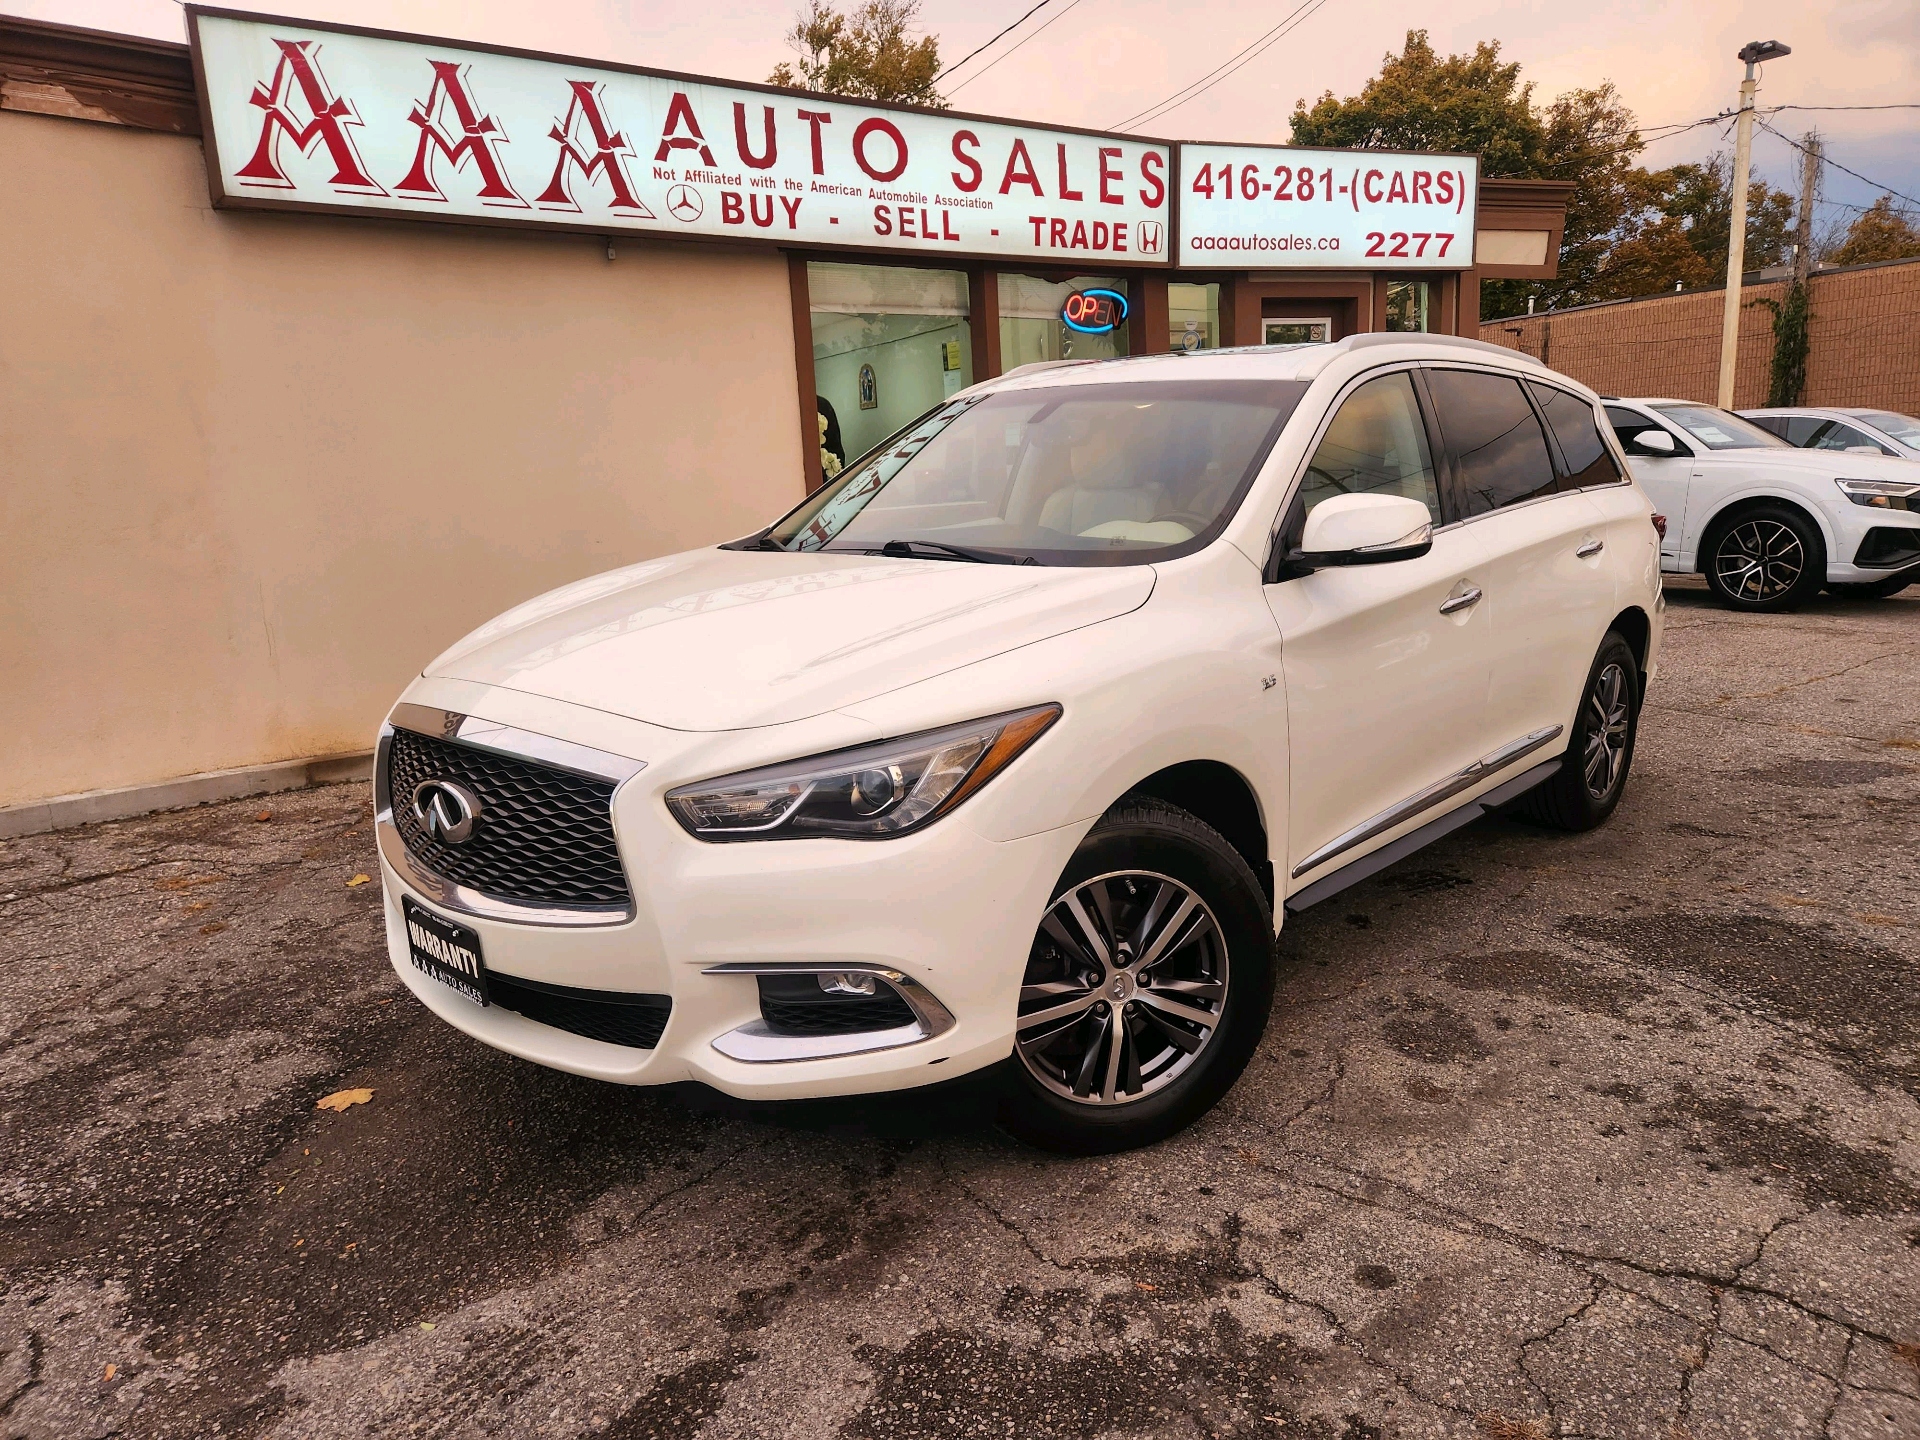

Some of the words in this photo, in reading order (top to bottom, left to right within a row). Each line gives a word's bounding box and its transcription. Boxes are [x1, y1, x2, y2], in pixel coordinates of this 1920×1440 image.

[654, 92, 909, 183] AUTO
[951, 129, 1165, 209] SALES
[653, 167, 677, 181] Not
[684, 169, 742, 187] Affiliated
[750, 175, 777, 190] with
[784, 176, 804, 192] the
[810, 180, 863, 198] American
[868, 187, 929, 205] Automobile
[934, 193, 994, 211] Association
[1192, 163, 1466, 214] 416-281-(CARS)
[721, 191, 803, 230] BUY
[874, 204, 961, 242] SELL
[1028, 216, 1128, 253] TRADE
[1191, 234, 1340, 252] aaaautosales.ca
[1364, 231, 1455, 258] 2277
[1066, 294, 1123, 327] OPEN
[408, 918, 479, 979] WARRANTY
[458, 981, 483, 1003] SALES
